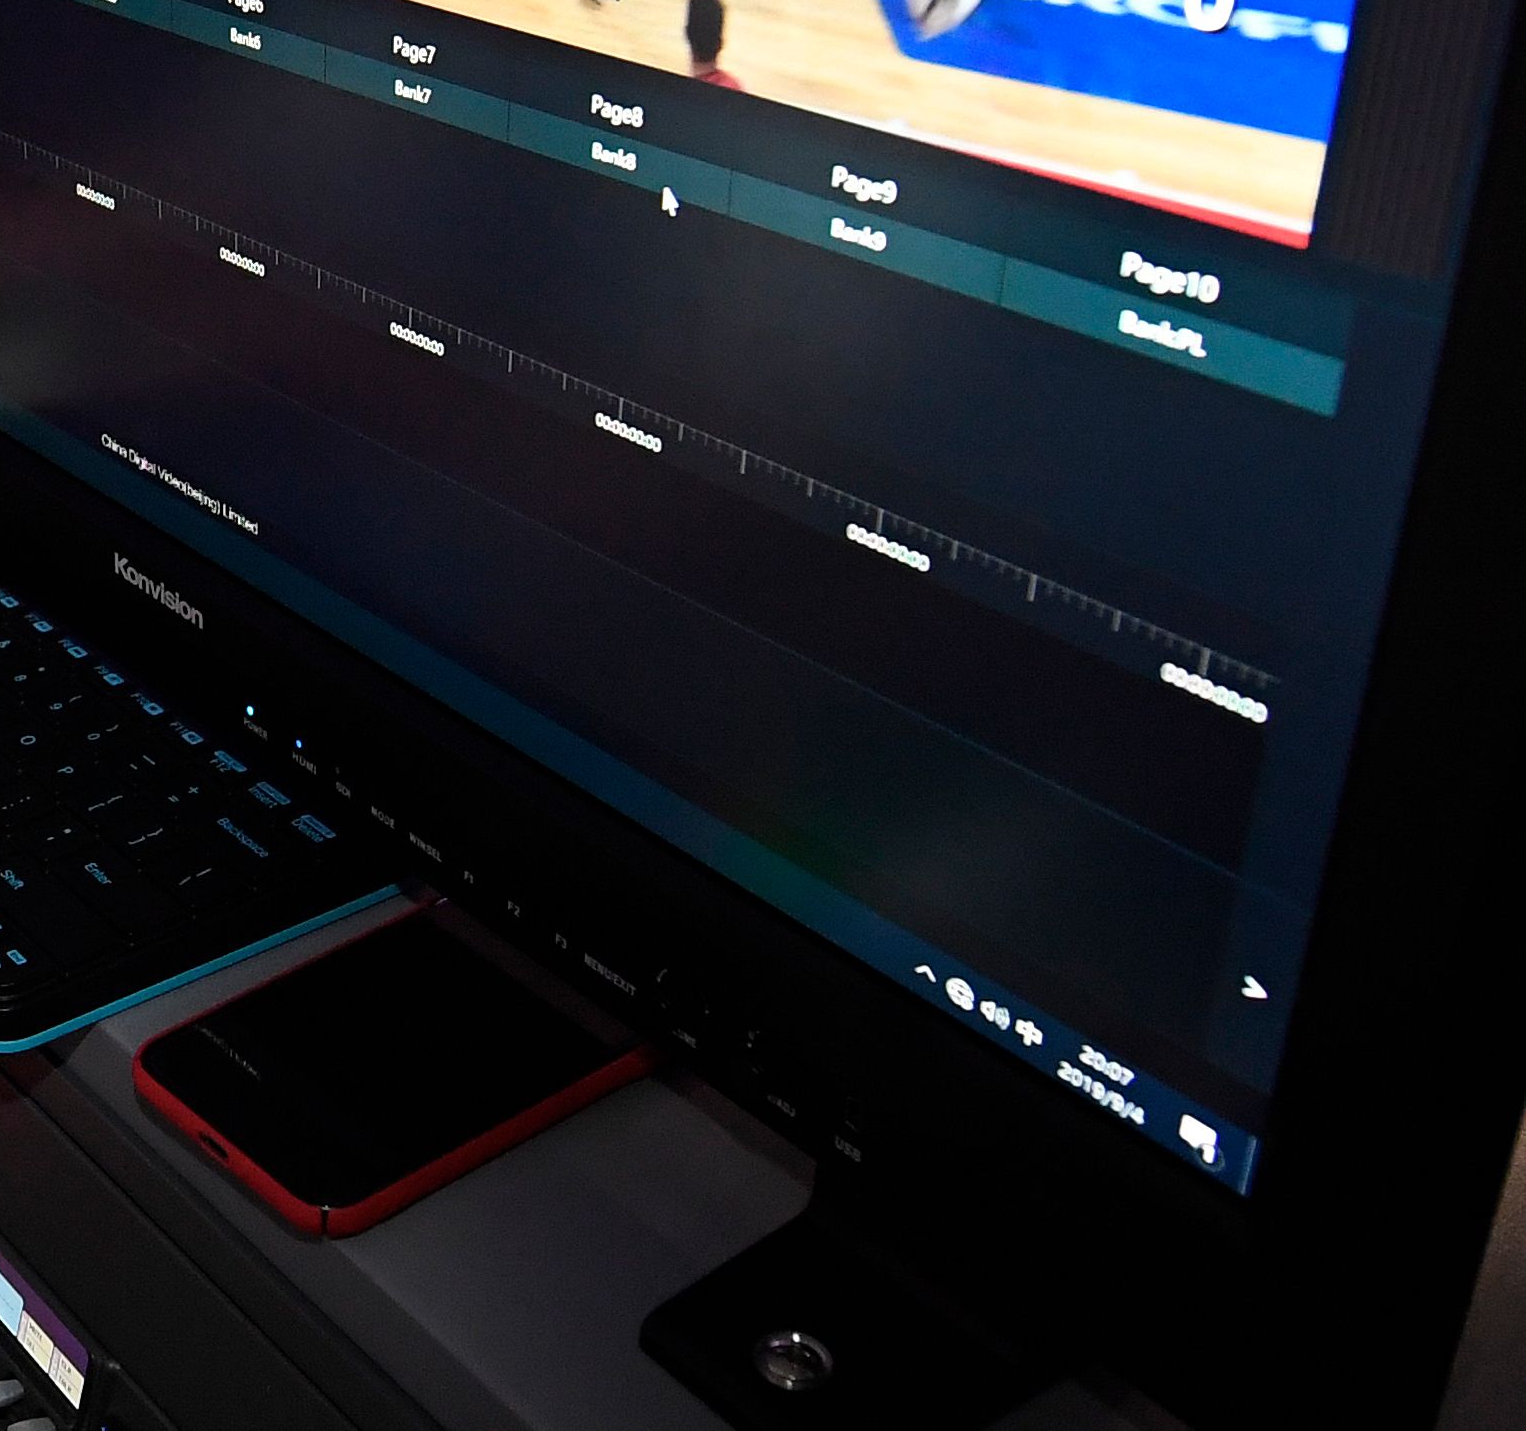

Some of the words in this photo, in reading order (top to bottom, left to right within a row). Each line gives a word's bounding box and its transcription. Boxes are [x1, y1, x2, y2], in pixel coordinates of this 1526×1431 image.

[394, 36, 436, 64] Page7
[395, 80, 431, 103] Bank7
[591, 94, 643, 127] Page8
[832, 166, 897, 204] Page9
[1120, 252, 1220, 303] Page10
[114, 551, 204, 630] Konvision
[216, 817, 270, 858] Backspace
[84, 862, 113, 886] Enter
